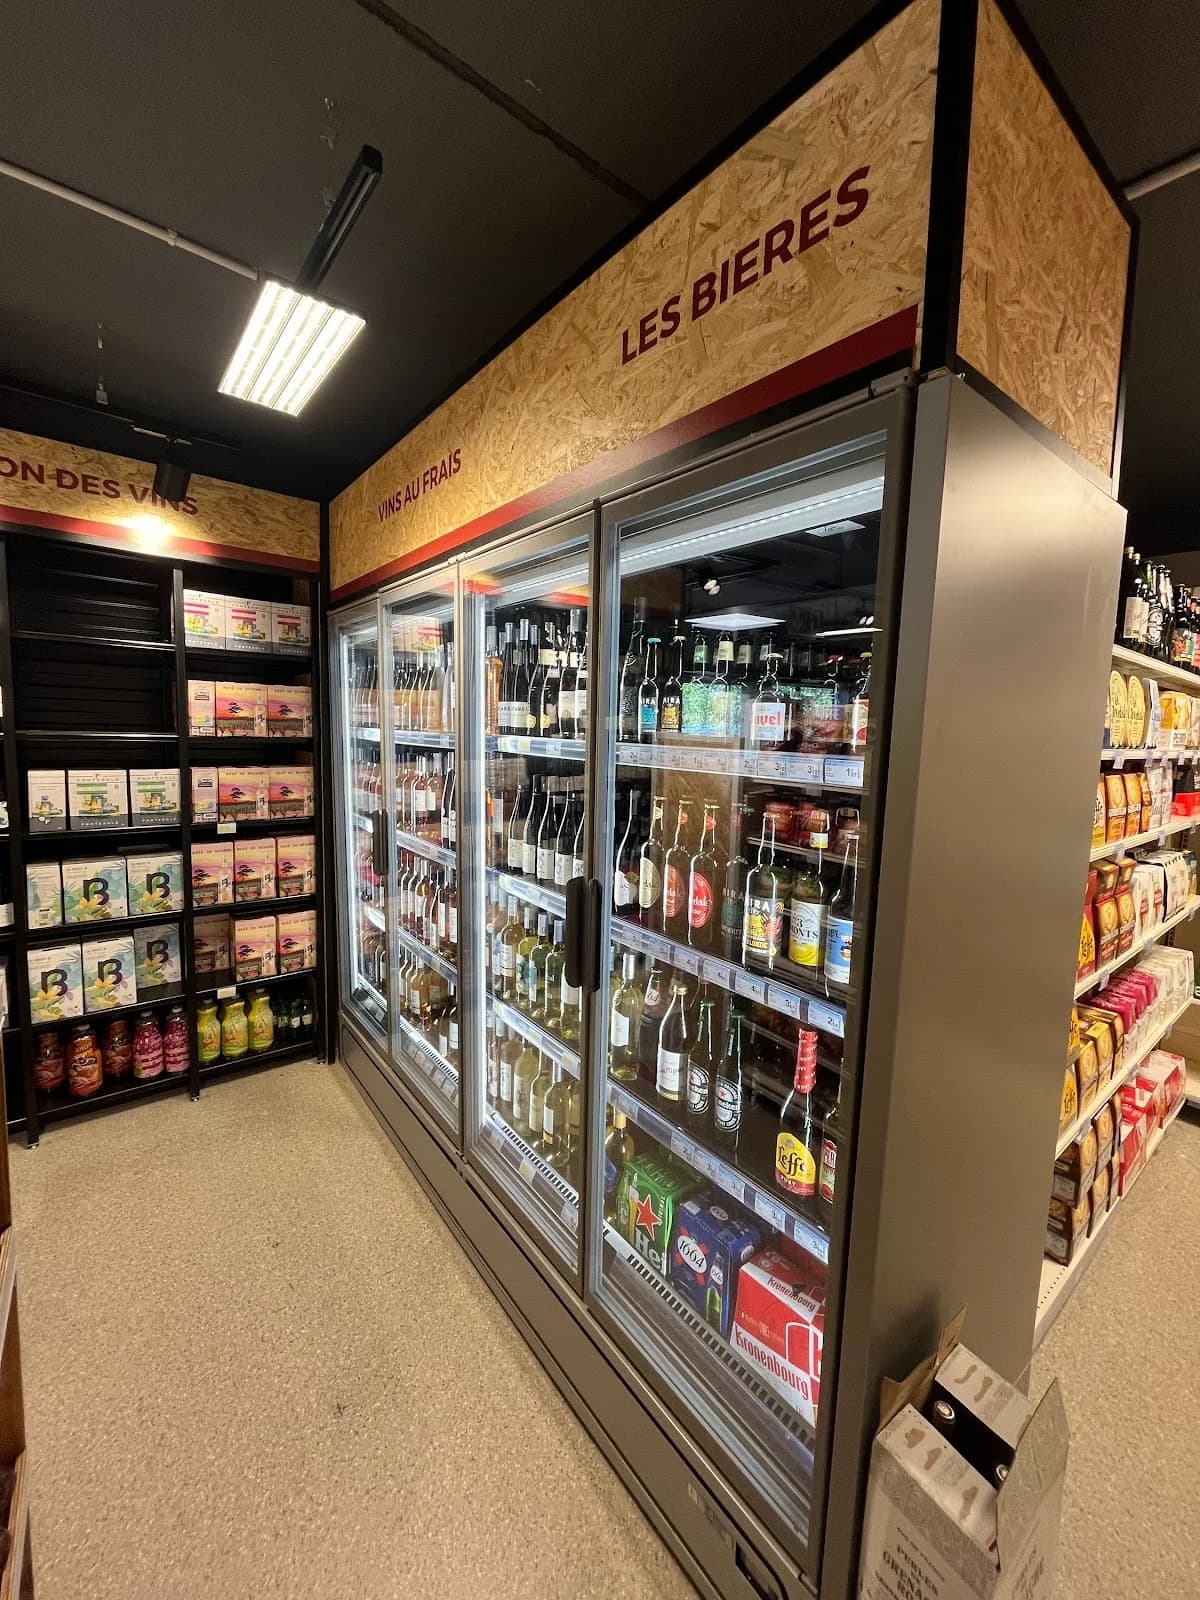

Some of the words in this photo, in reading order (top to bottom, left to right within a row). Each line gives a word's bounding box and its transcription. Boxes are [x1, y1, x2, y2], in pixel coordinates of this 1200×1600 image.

[622, 295, 681, 365] LES
[691, 165, 871, 322] BIERES
[55, 468, 121, 499] DES
[379, 490, 402, 522] VINS
[404, 477, 420, 507] AU
[422, 448, 462, 494] FRAIS
[777, 1146, 806, 1177] Leffe
[679, 1240, 705, 1268] 1664
[735, 1323, 809, 1401] Kronenbourg
